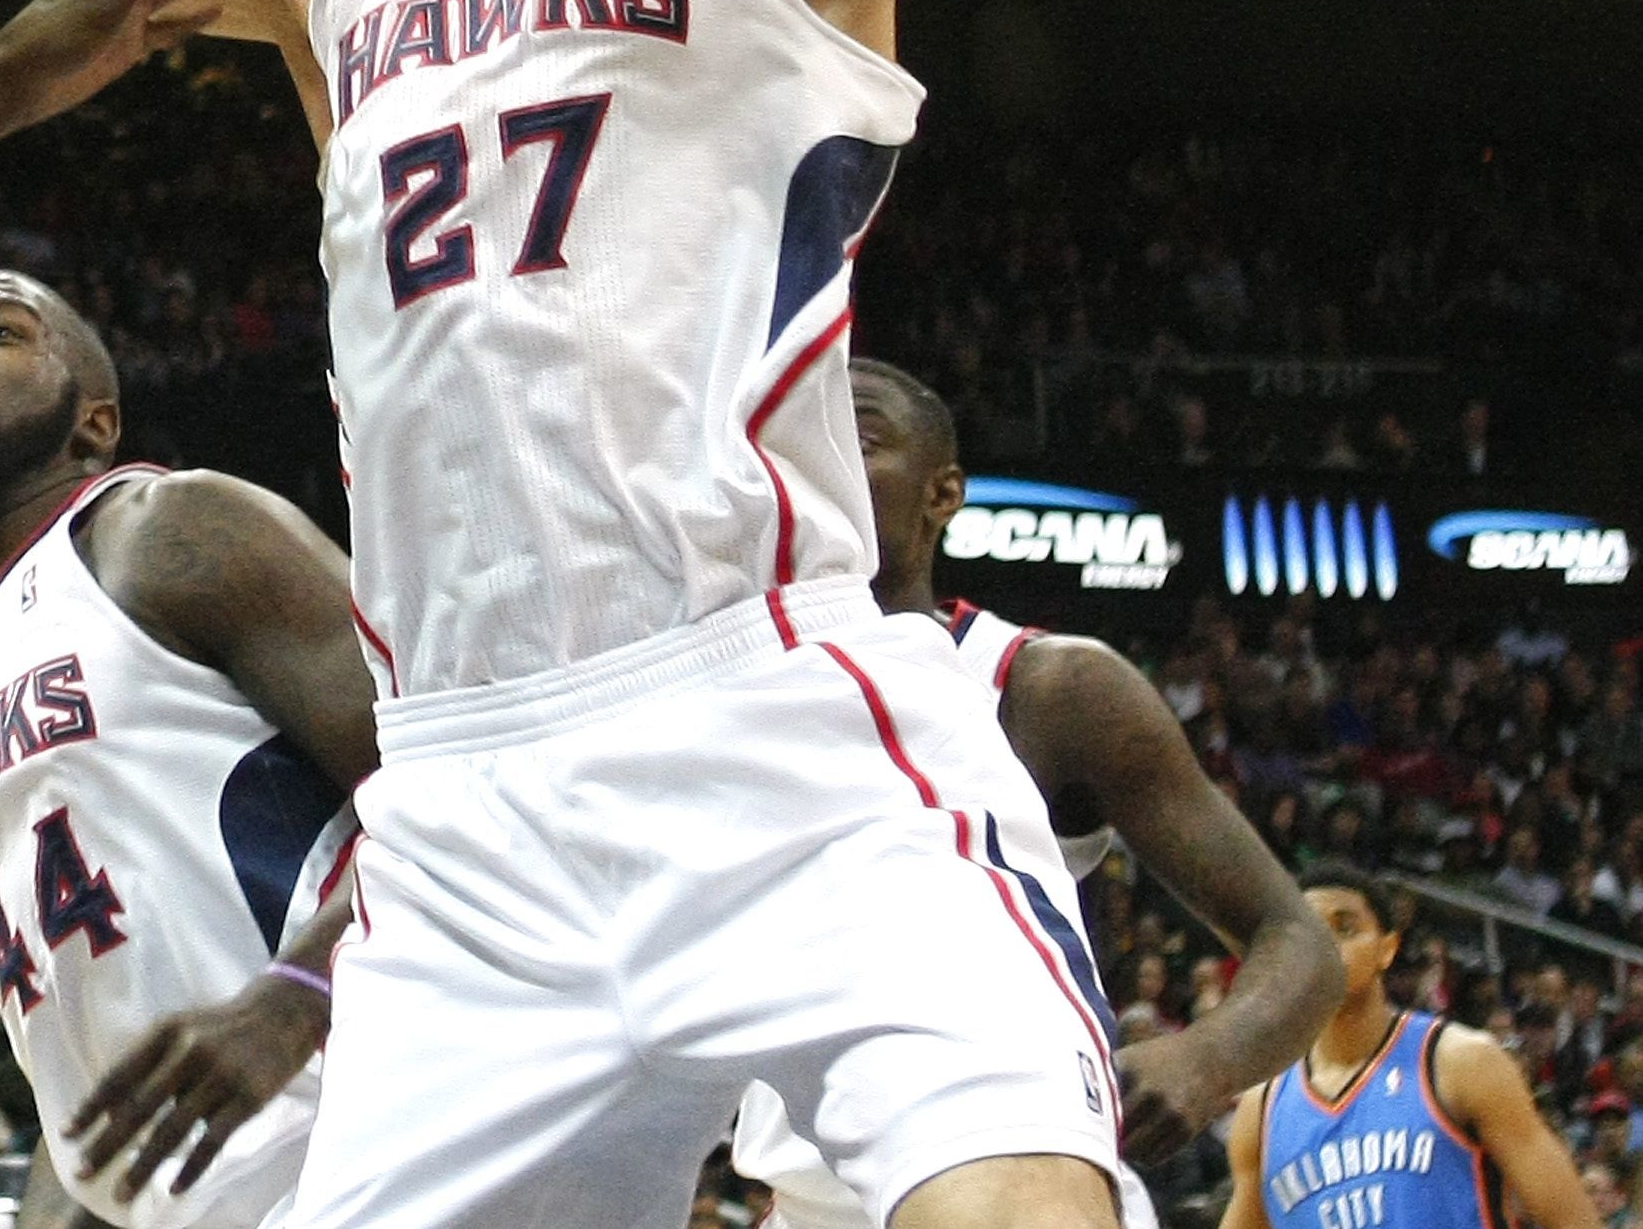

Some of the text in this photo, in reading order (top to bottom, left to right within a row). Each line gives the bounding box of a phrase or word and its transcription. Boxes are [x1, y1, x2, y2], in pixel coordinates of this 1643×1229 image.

[379, 92, 613, 311] 27
[942, 506, 1169, 564] SCANA
[1467, 529, 1631, 570] SCANA
[1318, 1183, 1384, 1229] CITY
